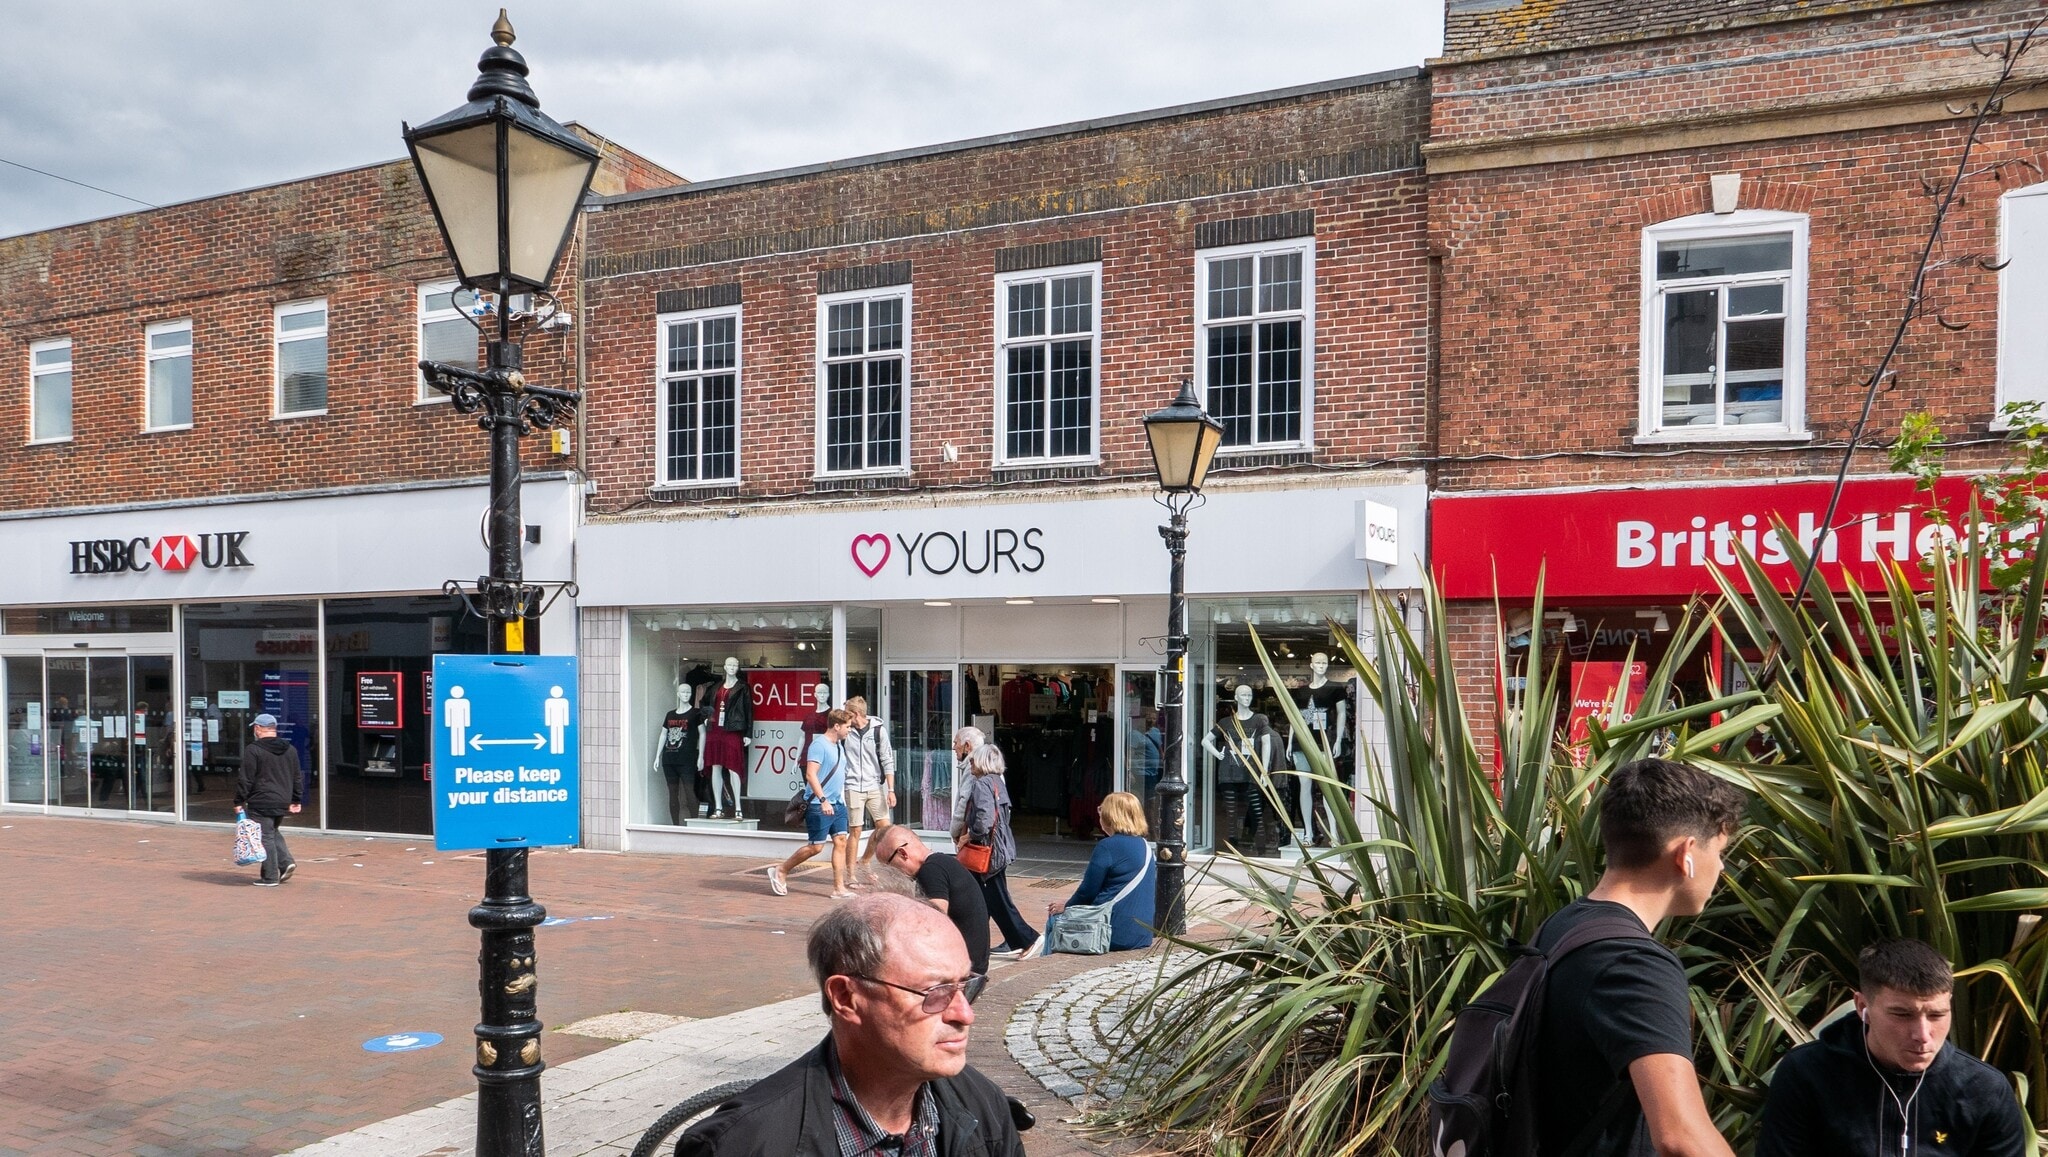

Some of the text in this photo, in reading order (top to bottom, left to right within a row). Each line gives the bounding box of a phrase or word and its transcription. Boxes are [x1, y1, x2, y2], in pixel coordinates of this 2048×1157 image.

[1376, 526, 1396, 543] YOURS
[1616, 511, 1839, 569] British
[69, 530, 255, 575] HSBC UK
[896, 527, 1045, 577] YOURS
[68, 610, 105, 622] Welcome
[752, 683, 815, 707] SALE
[1574, 699, 1600, 708] We're
[754, 729, 785, 740] UP TO
[455, 766, 561, 785] Please keep
[447, 787, 568, 809] your distance
